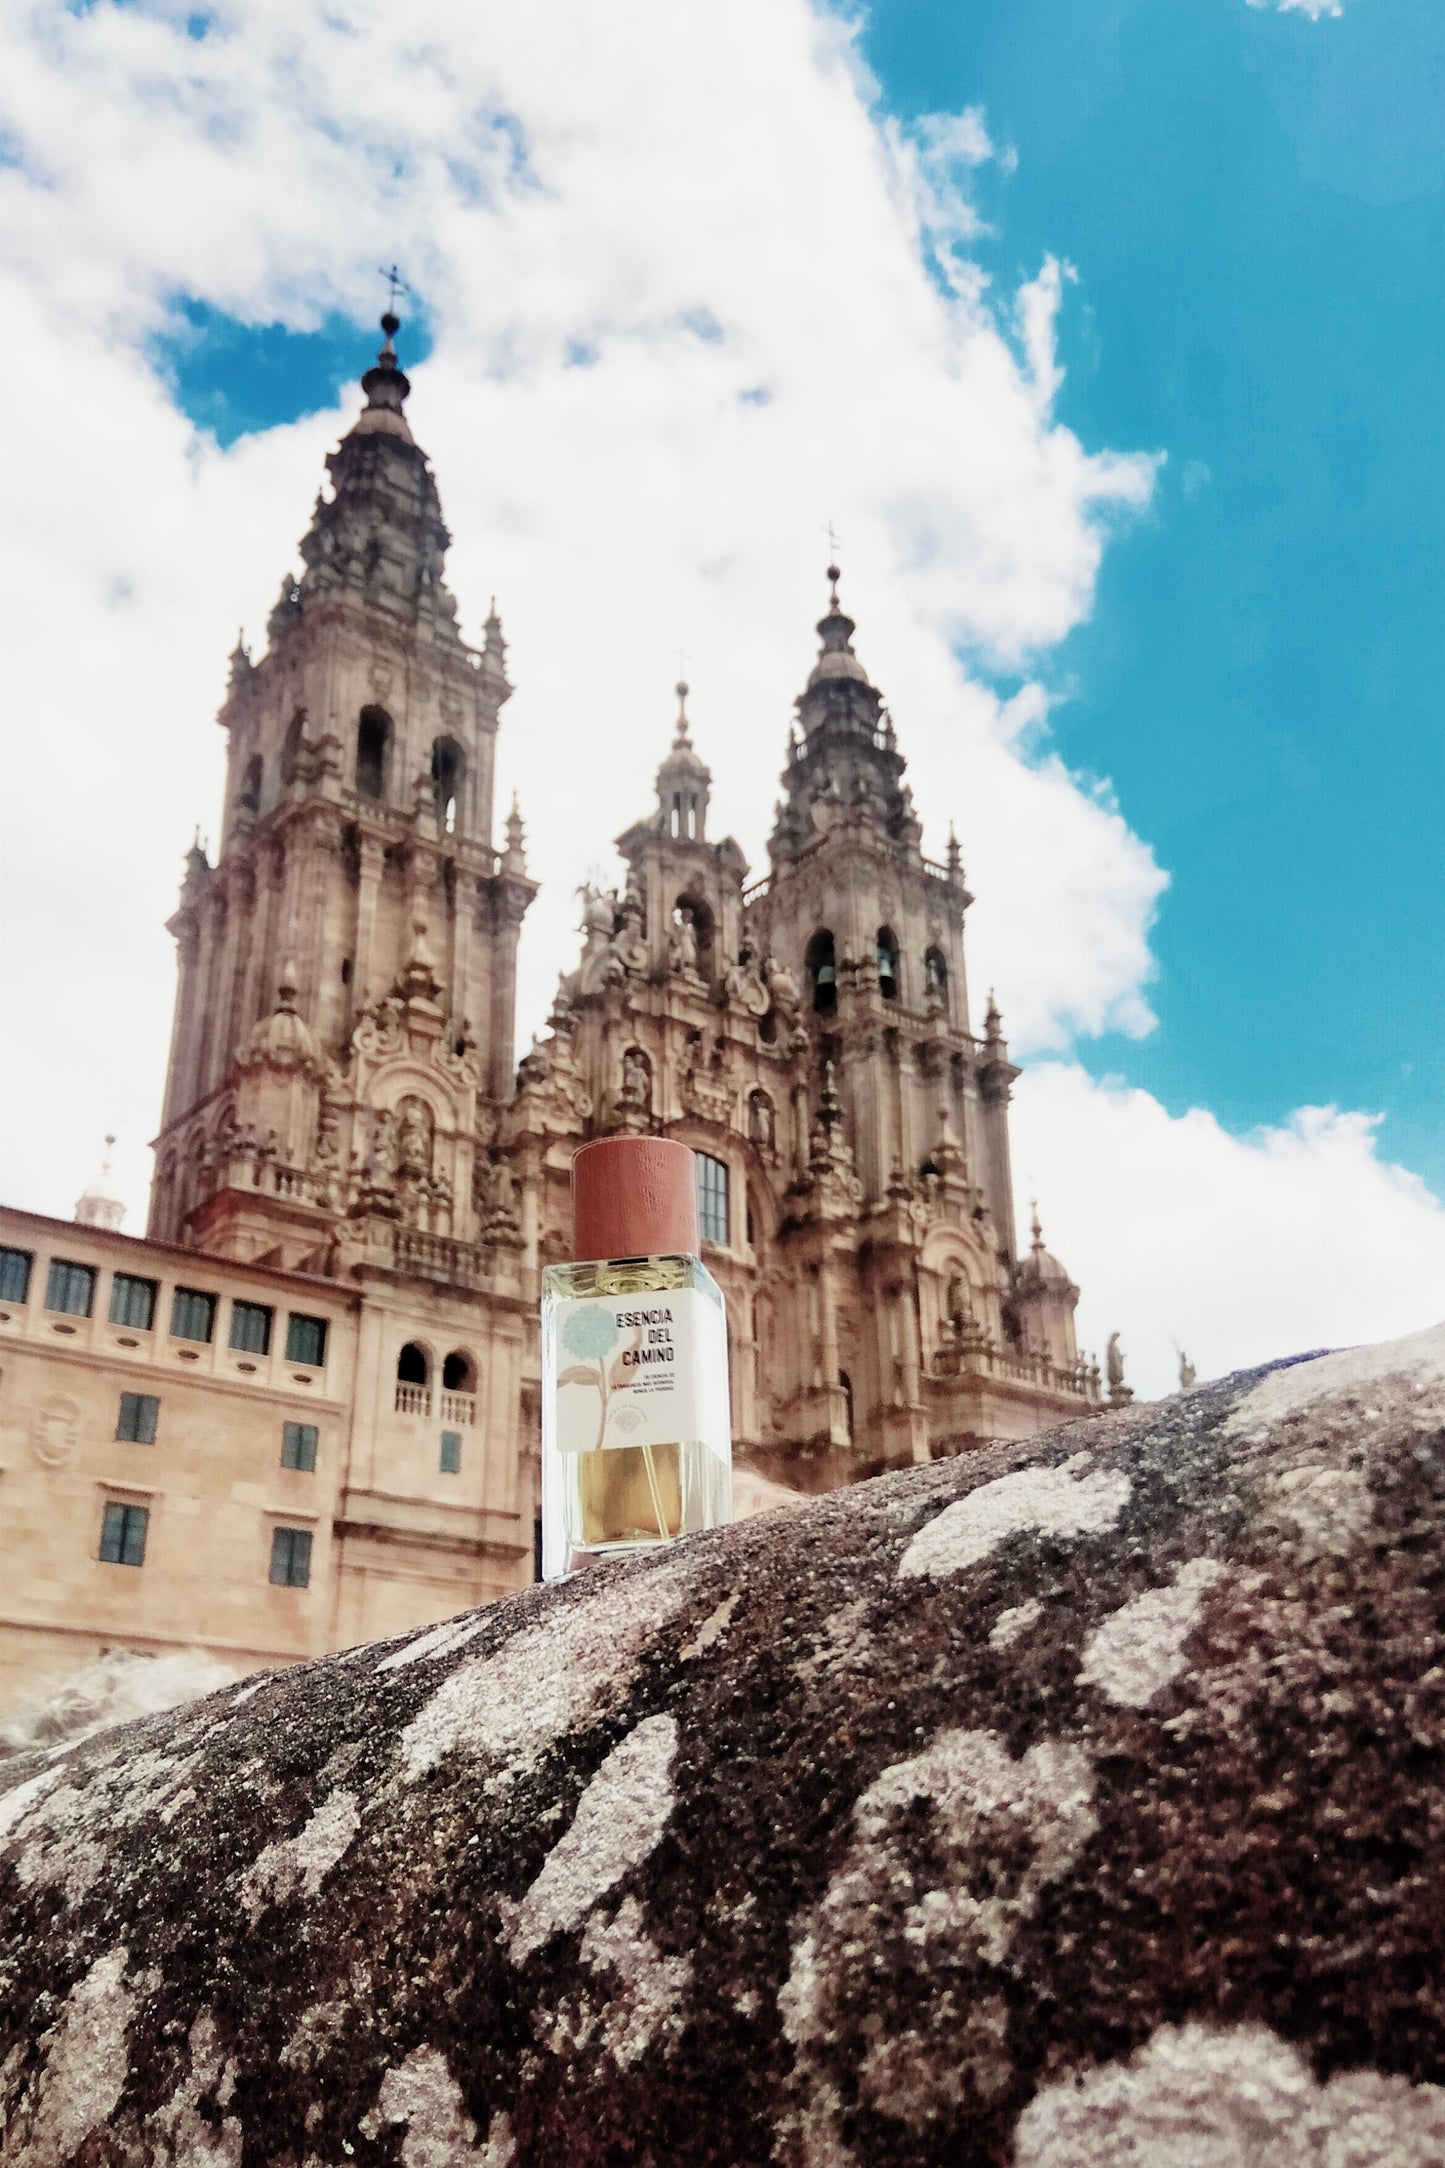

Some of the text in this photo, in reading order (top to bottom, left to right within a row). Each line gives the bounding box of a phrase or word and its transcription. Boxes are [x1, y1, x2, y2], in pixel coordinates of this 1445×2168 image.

[616, 1308, 674, 1328] ESENCIA
[648, 1328, 674, 1344] DEL
[622, 1347, 674, 1366] CAMINO
